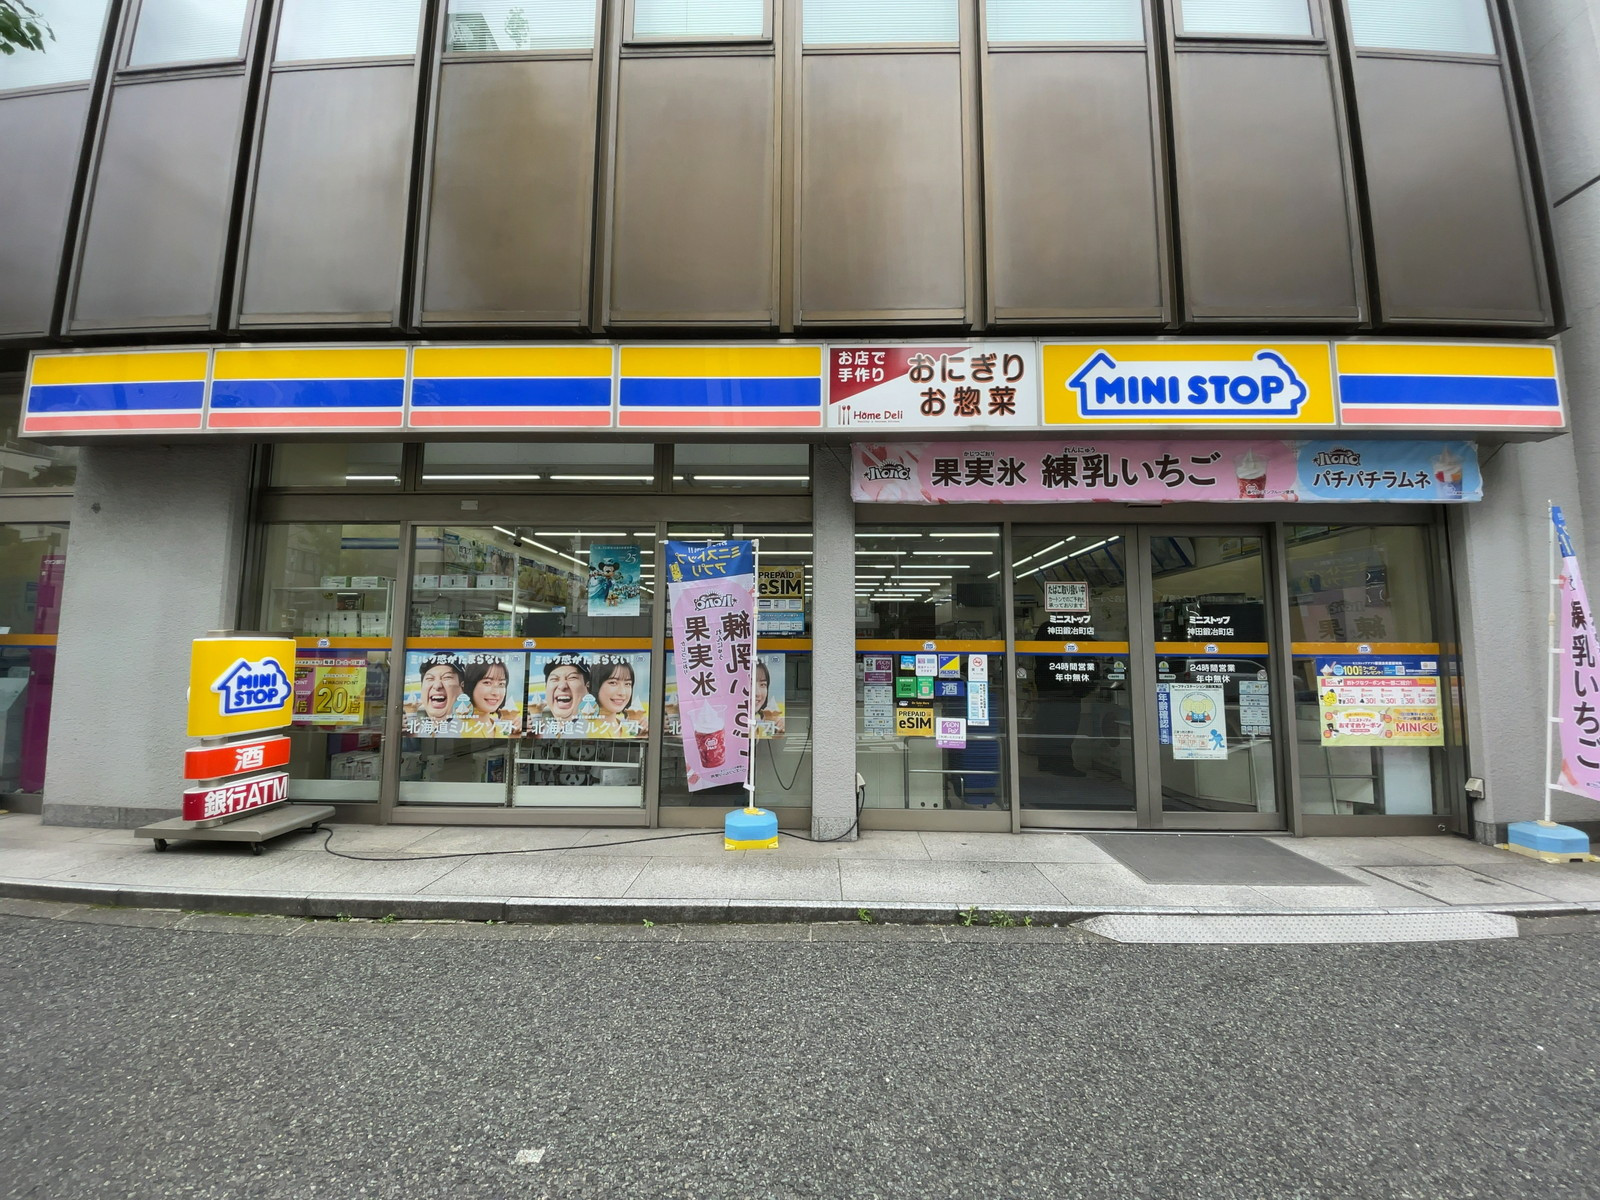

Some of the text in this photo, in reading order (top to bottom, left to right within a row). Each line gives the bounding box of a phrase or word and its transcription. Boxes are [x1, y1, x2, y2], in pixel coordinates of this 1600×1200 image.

[838, 351, 885, 366] お店で
[838, 367, 885, 383] 手作り
[908, 352, 1025, 384] おにぎり
[1095, 375, 1285, 405] MINI STOP
[919, 386, 1017, 417] お惣菜
[853, 410, 903, 420] Home Deli
[931, 451, 1222, 488] 果実氷 練乳いちご
[1313, 469, 1431, 489] パチパチラムネ
[758, 579, 802, 595] eSIM
[1049, 615, 1091, 624] ミニストップ
[1189, 616, 1231, 624] ミニストップ
[1049, 663, 1095, 671] 24時間営業
[1189, 664, 1236, 672] 24時間営業
[1343, 665, 1359, 676] 100
[236, 673, 278, 690] MINI
[1055, 673, 1089, 682] 年中無休
[1196, 675, 1231, 683] 年中無休
[942, 682, 958, 695] 酒
[234, 687, 279, 707] STOP
[407, 719, 518, 735] 北海道ミルクソフト
[531, 719, 644, 736] 北海道ミルクソフト
[898, 717, 932, 729] eSIM
[234, 745, 265, 772] 酒
[204, 775, 288, 819] 銀行ATM
